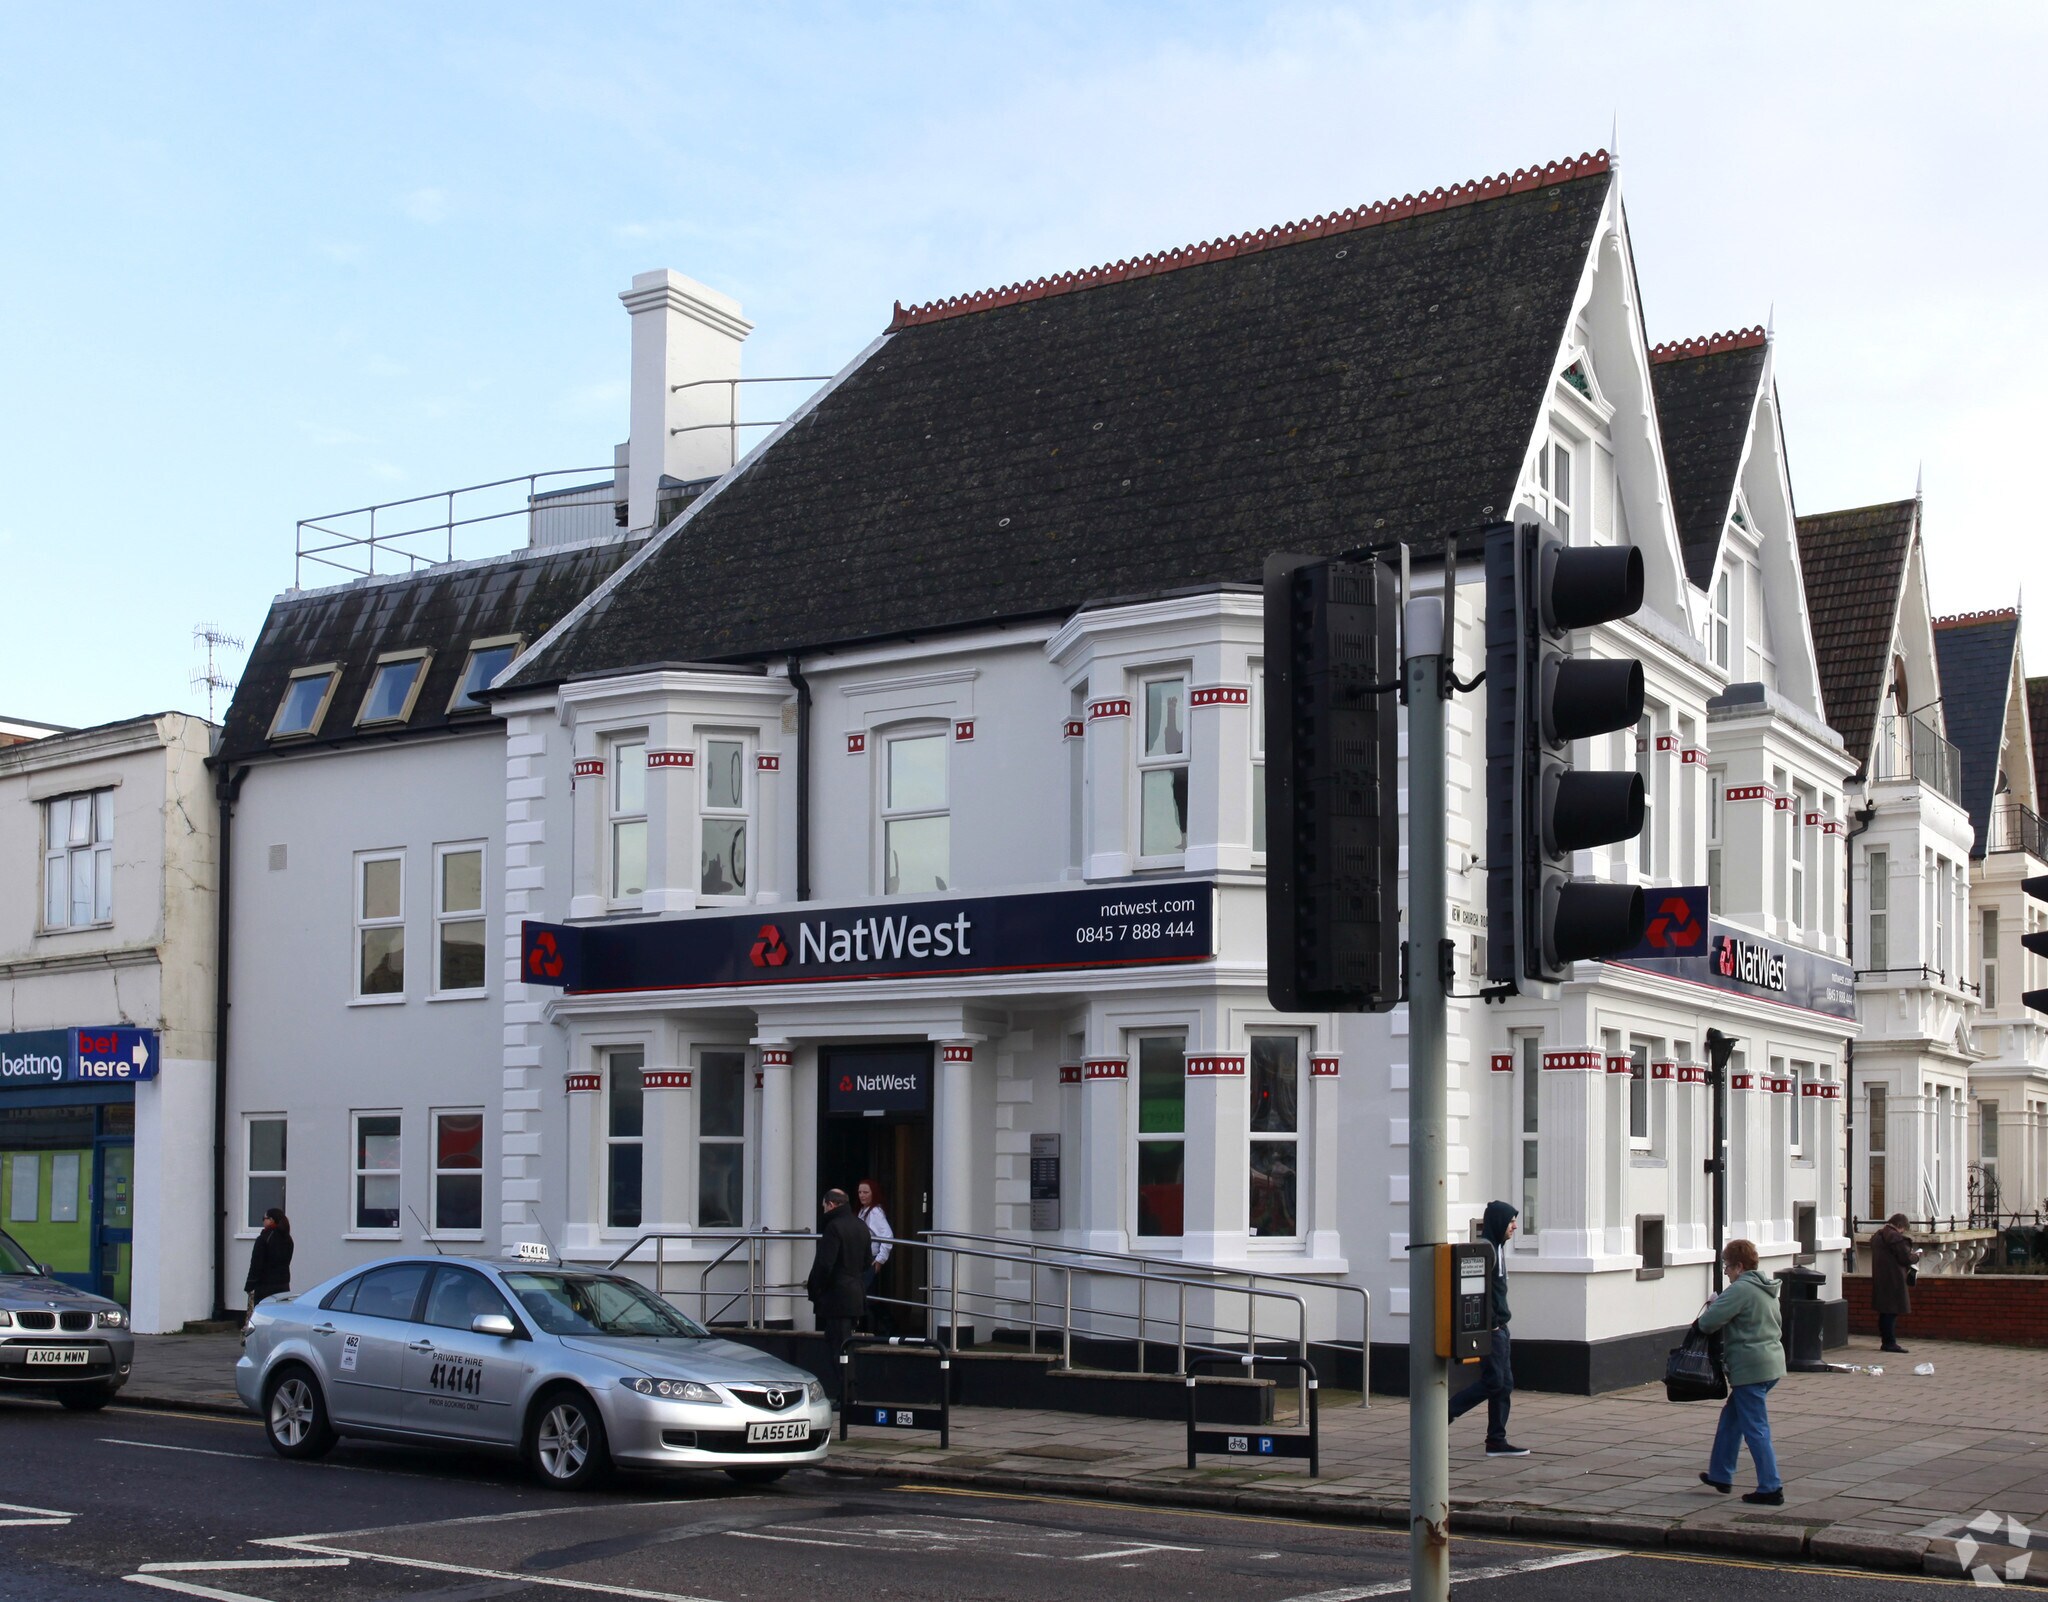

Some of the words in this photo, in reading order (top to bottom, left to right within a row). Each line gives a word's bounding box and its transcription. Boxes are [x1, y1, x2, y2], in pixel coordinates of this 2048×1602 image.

[1101, 899, 1195, 917] natwest.com
[799, 911, 971, 965] NatWest
[1076, 926, 1114, 943] 0845
[1118, 925, 1128, 941] 7
[1132, 922, 1161, 940] 888
[1165, 920, 1195, 938] 444
[1735, 939, 1787, 992] NatWest
[79, 1031, 119, 1054] bet
[2, 1052, 63, 1081] betting
[79, 1056, 131, 1077] here
[856, 1074, 917, 1091] NatWest
[521, 1244, 529, 1254] 41
[530, 1245, 538, 1254] 41
[540, 1246, 547, 1255] 41
[346, 1336, 359, 1348] 462
[32, 1351, 62, 1362] AX04
[64, 1351, 85, 1362] MWN
[432, 1352, 463, 1364] PRIVATE
[465, 1357, 484, 1367] HIRE
[753, 1425, 785, 1440] LA55
[786, 1423, 806, 1438] EAX
